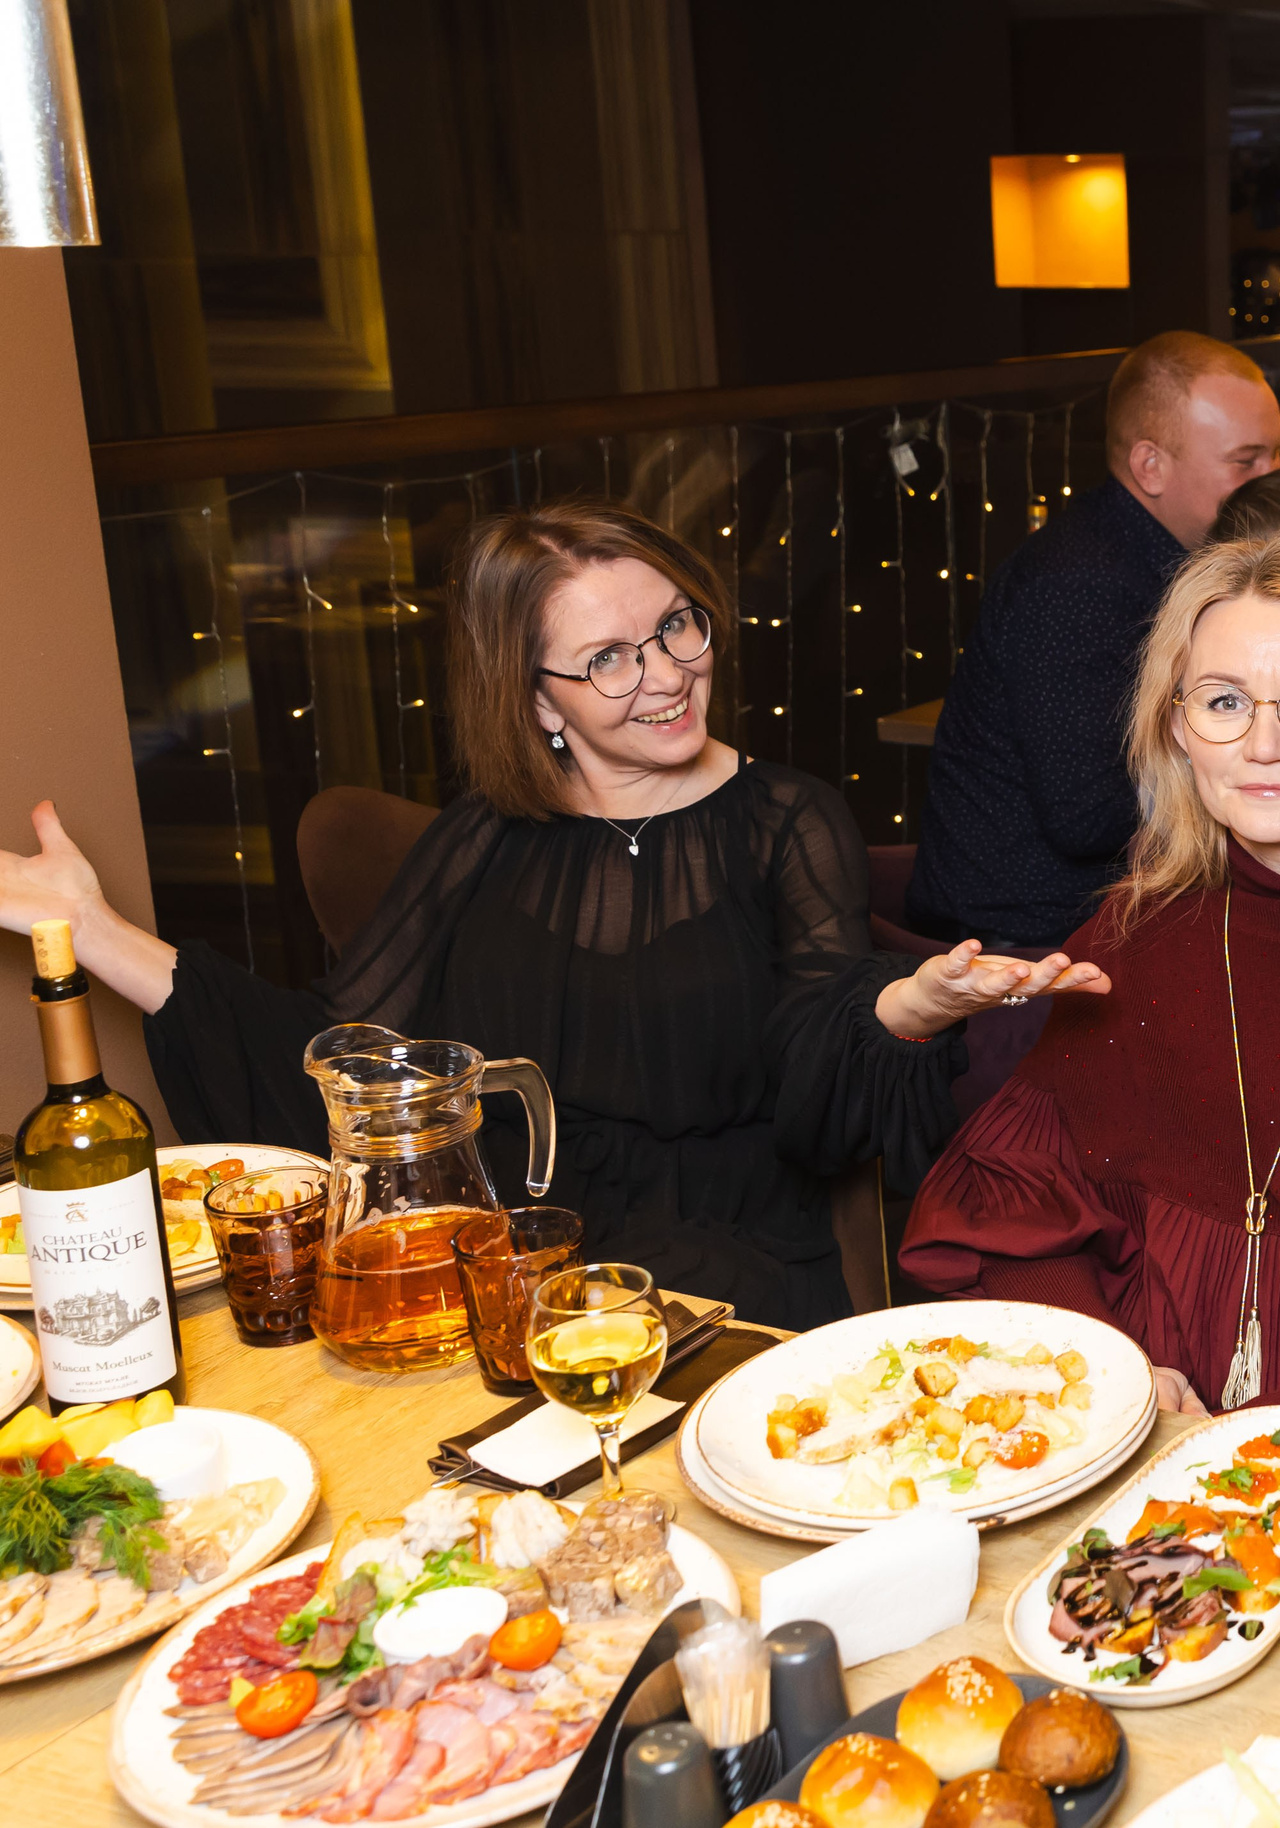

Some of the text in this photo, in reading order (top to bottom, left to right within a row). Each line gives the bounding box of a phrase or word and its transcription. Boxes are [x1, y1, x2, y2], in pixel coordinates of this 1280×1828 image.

[31, 1231, 147, 1263] ANTIQUE
[42, 1226, 122, 1246] CHATEAU
[52, 1350, 153, 1373] Muscat Moelleux
